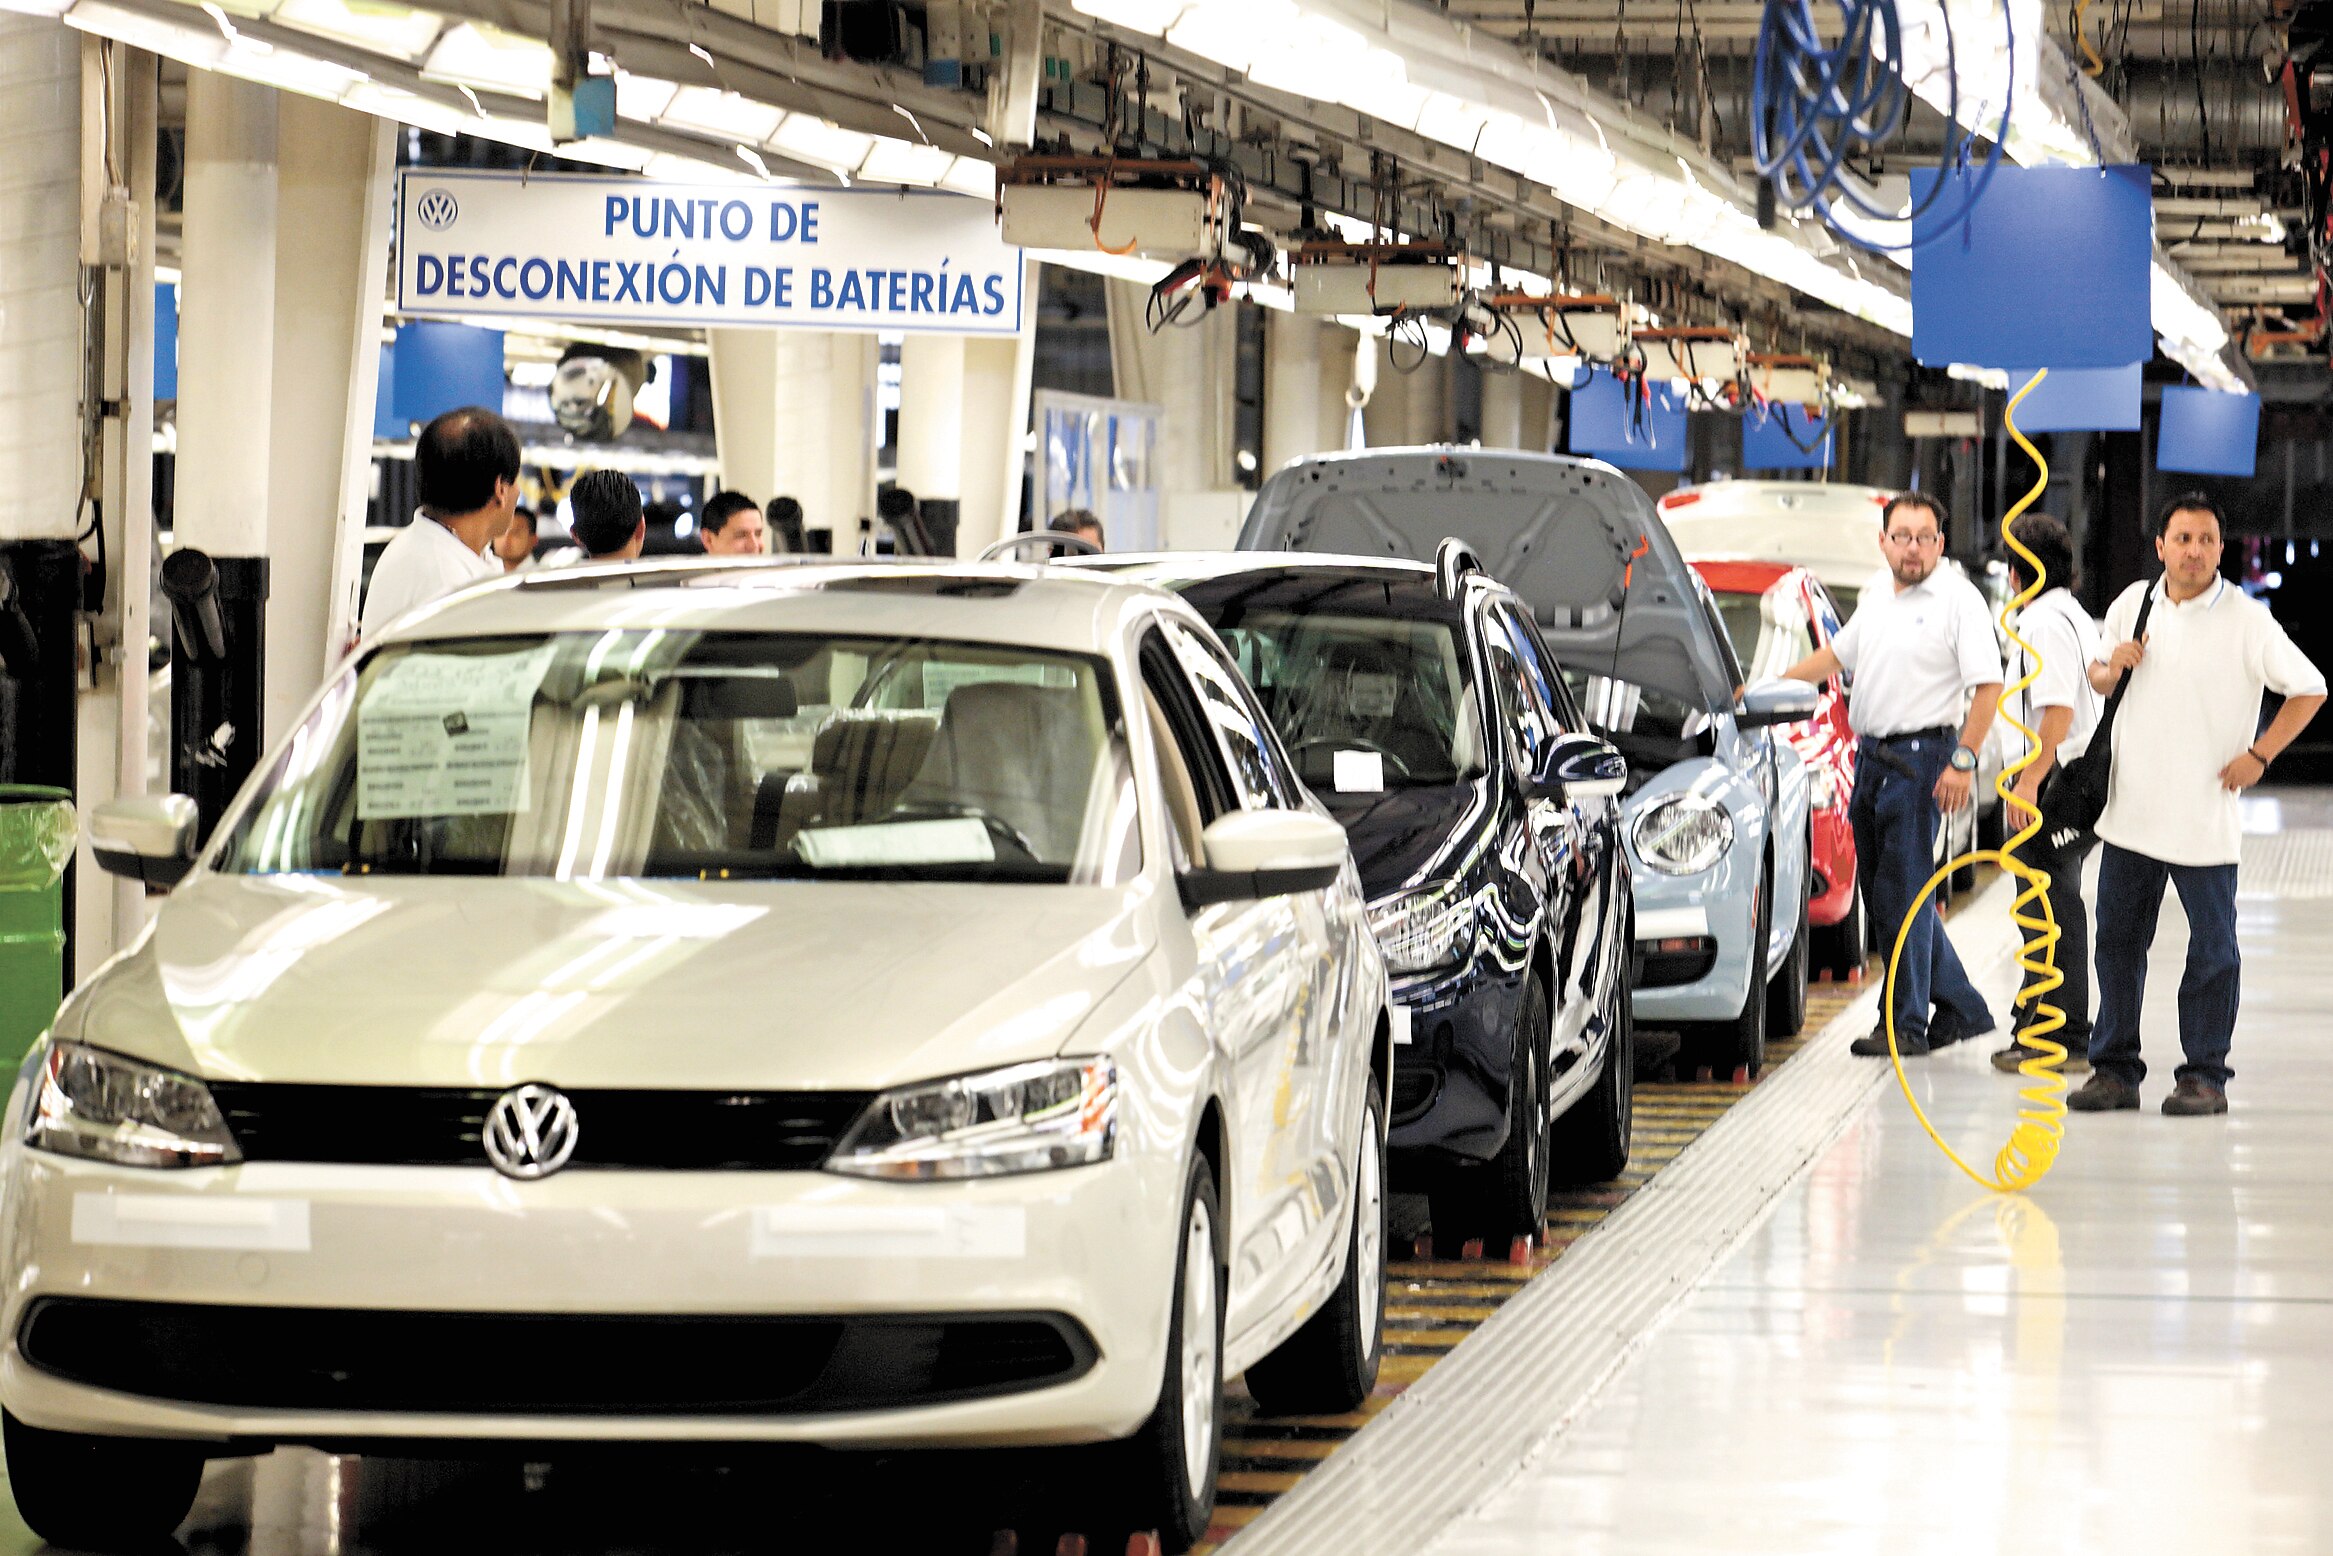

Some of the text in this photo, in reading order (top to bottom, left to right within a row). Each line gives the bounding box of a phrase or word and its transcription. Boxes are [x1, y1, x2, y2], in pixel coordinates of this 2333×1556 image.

[605, 196, 819, 243] PUNTO DE
[416, 249, 1005, 315] DESCONEXIÓN DE BATERÍAS
